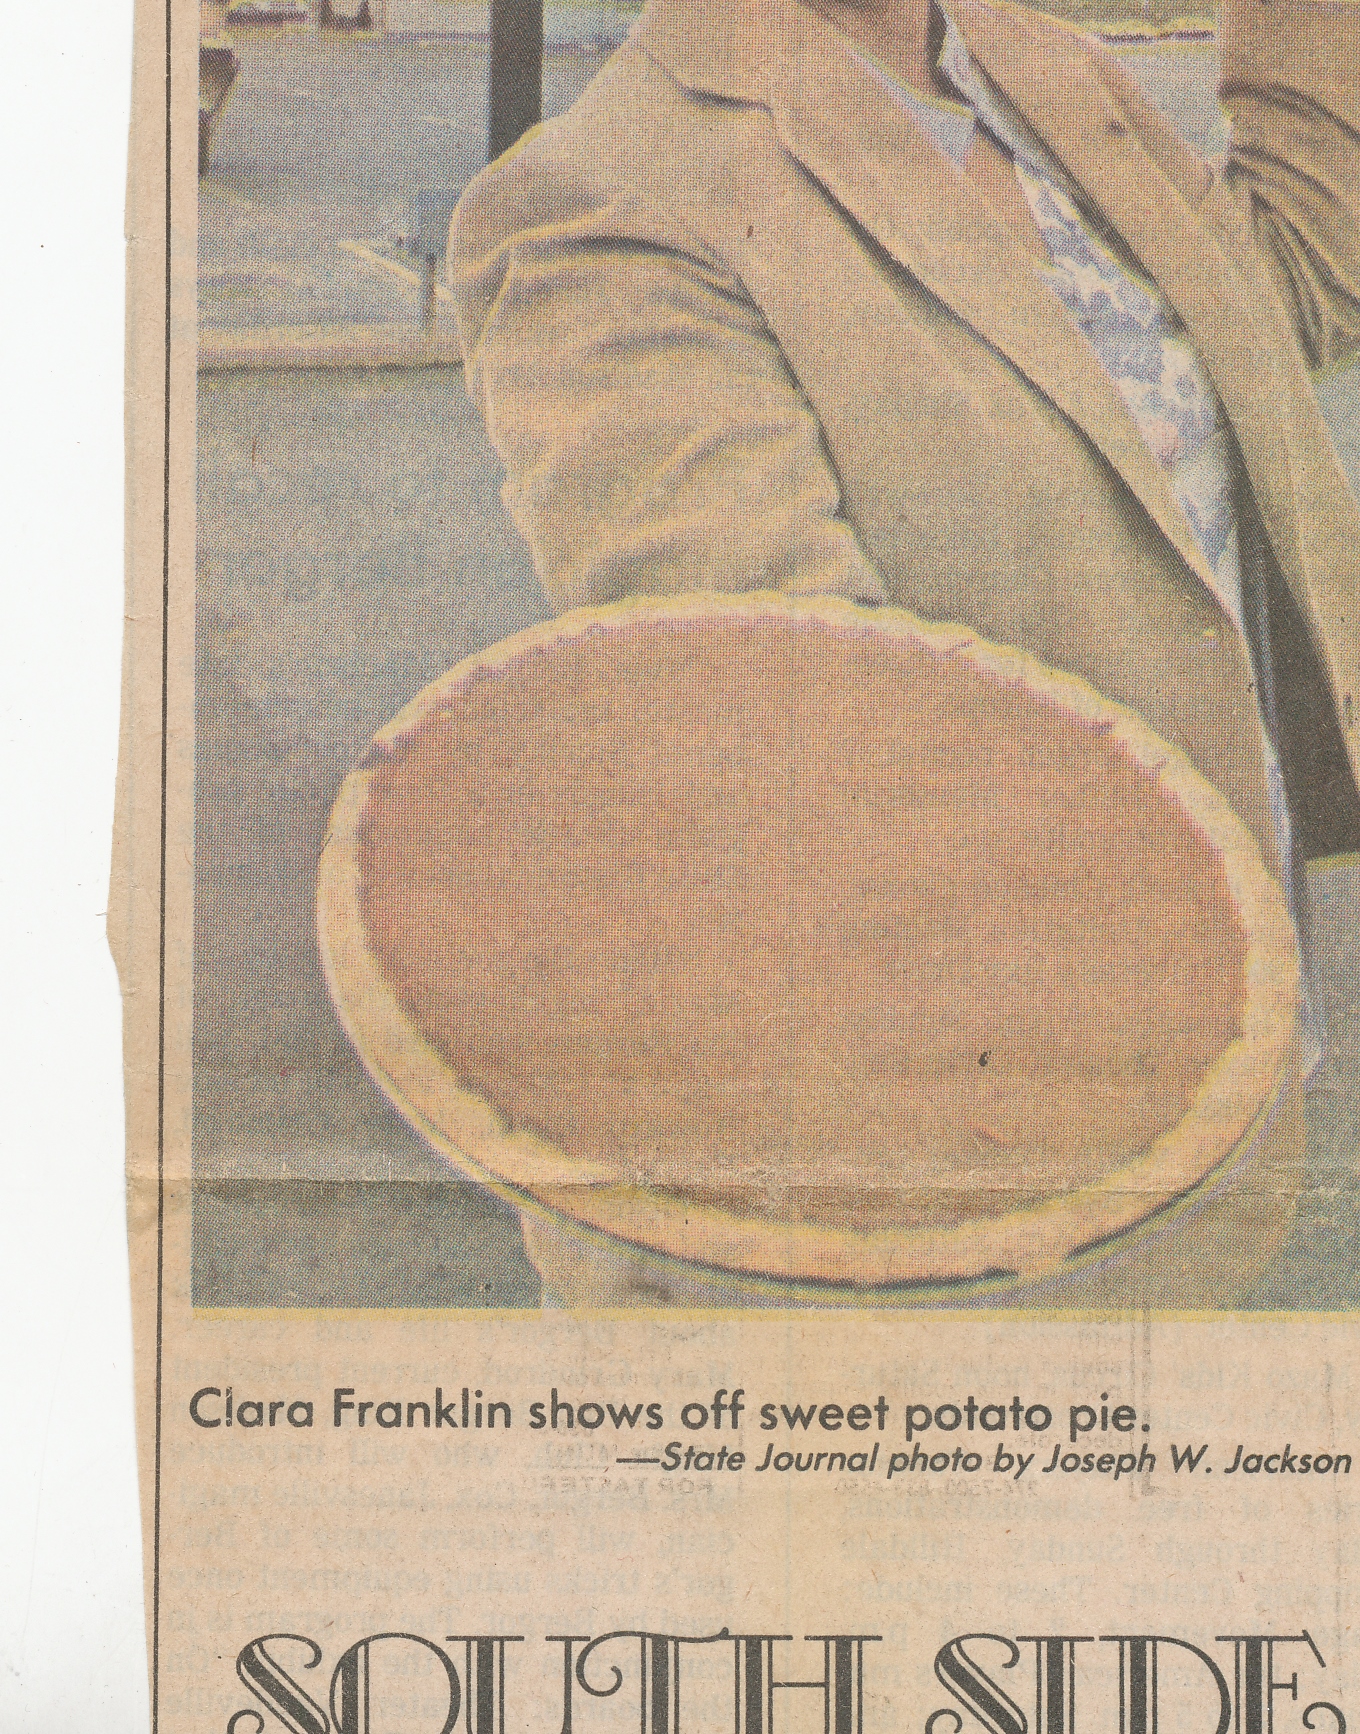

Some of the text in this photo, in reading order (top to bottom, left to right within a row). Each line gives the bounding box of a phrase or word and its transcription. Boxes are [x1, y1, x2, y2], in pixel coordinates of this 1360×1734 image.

[189, 1387, 1150, 1442] Clara Franklin shows off sweet potato pie.
[754, 1443, 880, 1472] Journal
[886, 1443, 983, 1479] photo
[992, 1443, 1035, 1480] by
[1042, 1443, 1157, 1481] Joseph
[1171, 1444, 1213, 1474] W.
[1224, 1443, 1352, 1474] Jackson
[226, 1627, 1347, 1734] SOUTH SIDE
